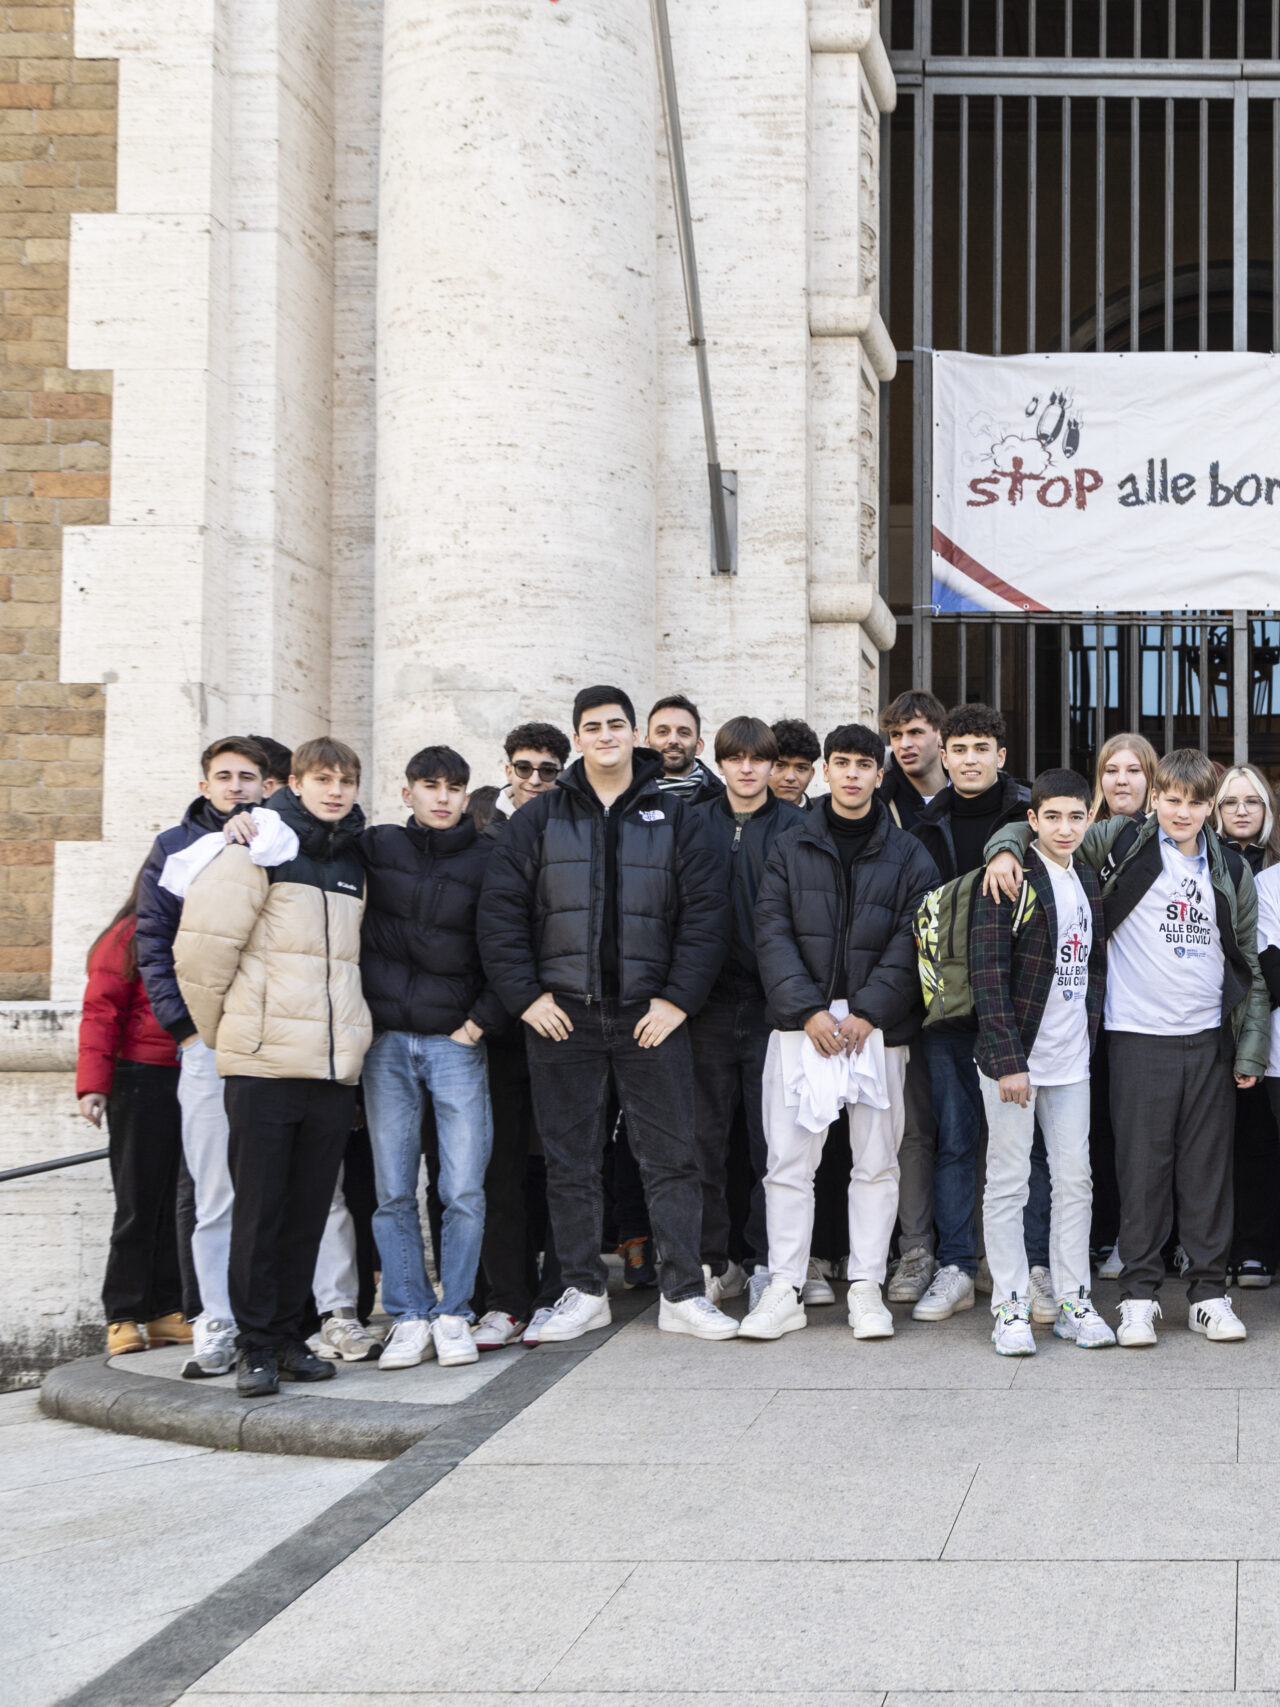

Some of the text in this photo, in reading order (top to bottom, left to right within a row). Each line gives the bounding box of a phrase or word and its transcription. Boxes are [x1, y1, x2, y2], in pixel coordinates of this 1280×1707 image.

[1117, 458, 1196, 507] alle
[1159, 923, 1184, 933] ALLE
[1166, 934, 1183, 943] SUI
